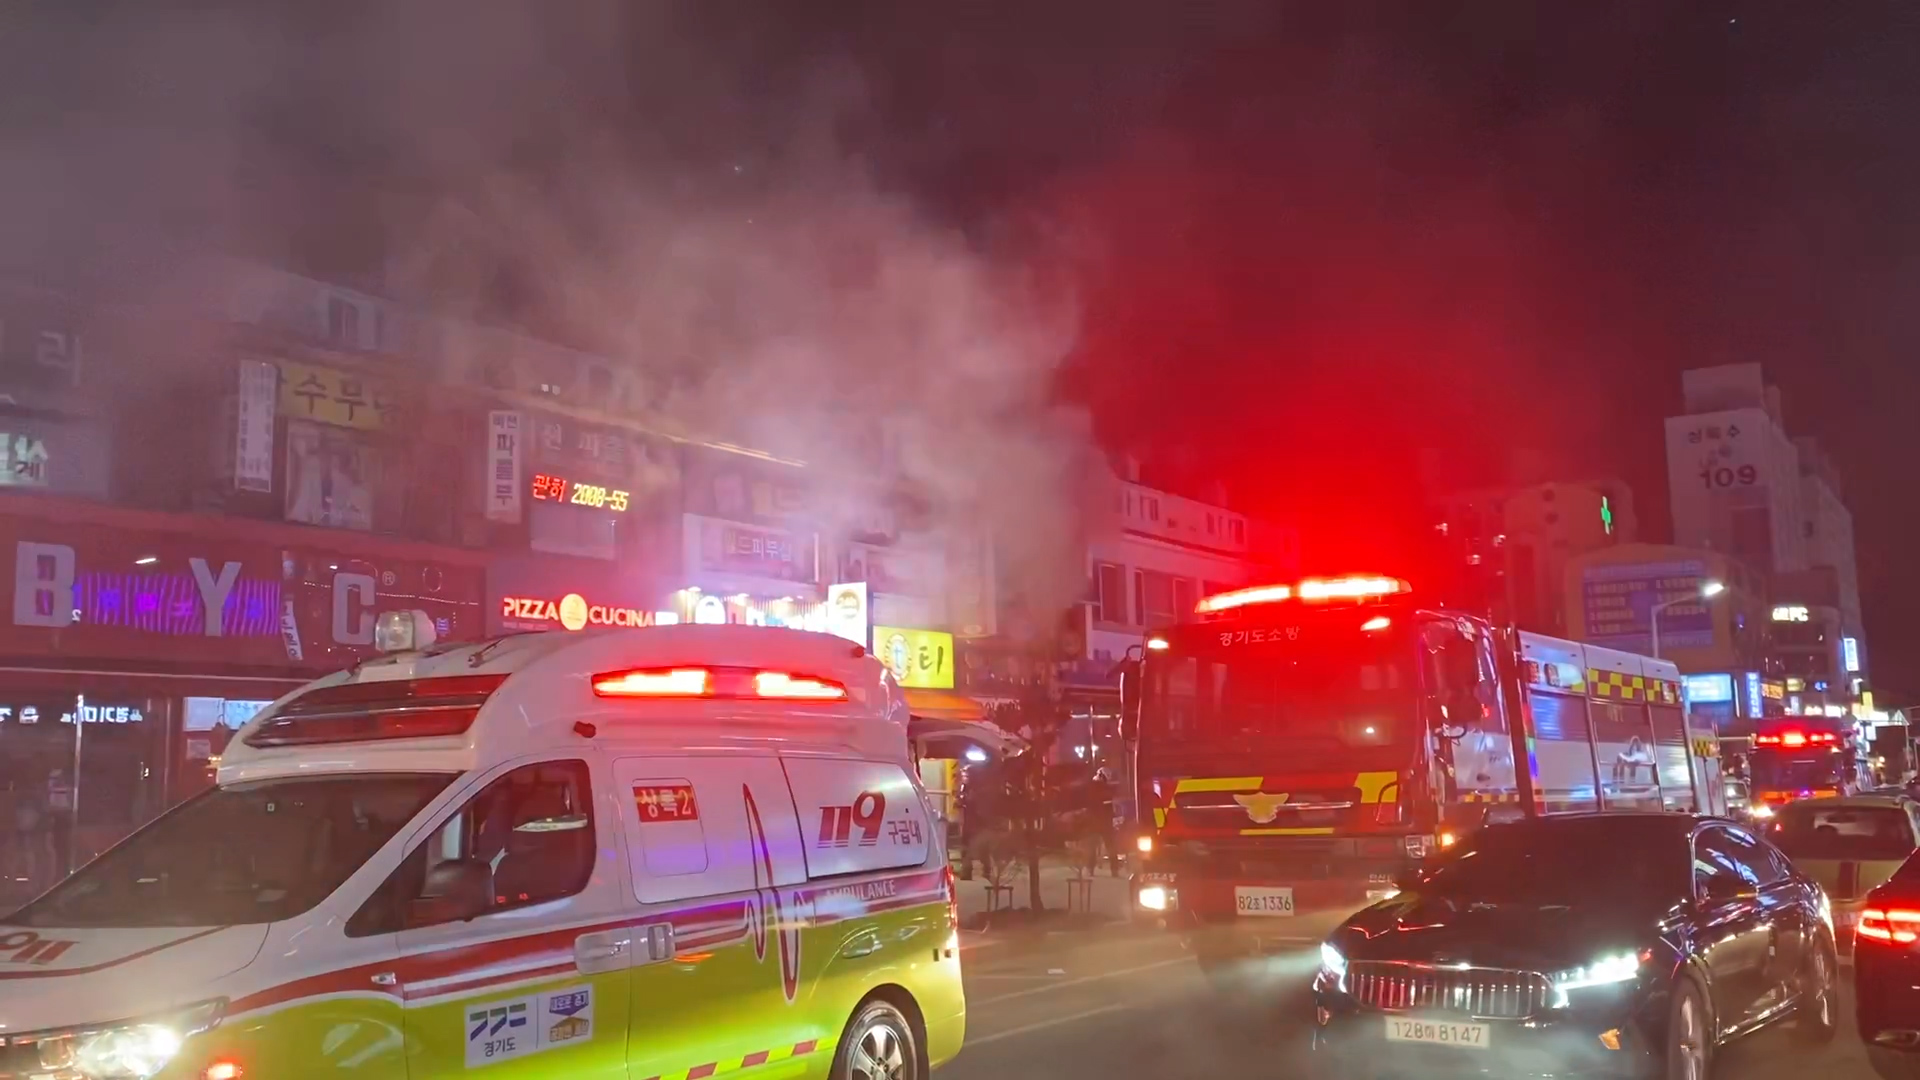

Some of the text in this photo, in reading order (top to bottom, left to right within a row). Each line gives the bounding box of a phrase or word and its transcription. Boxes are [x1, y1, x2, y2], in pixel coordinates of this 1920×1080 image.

[1700, 465, 1757, 489] 109
[503, 598, 655, 627] PIZZA CUCINA
[1219, 625, 1301, 647] 경기도소방
[817, 790, 886, 849] 119
[887, 820, 923, 846] 구급대
[484, 1037, 516, 1068] 경기도
